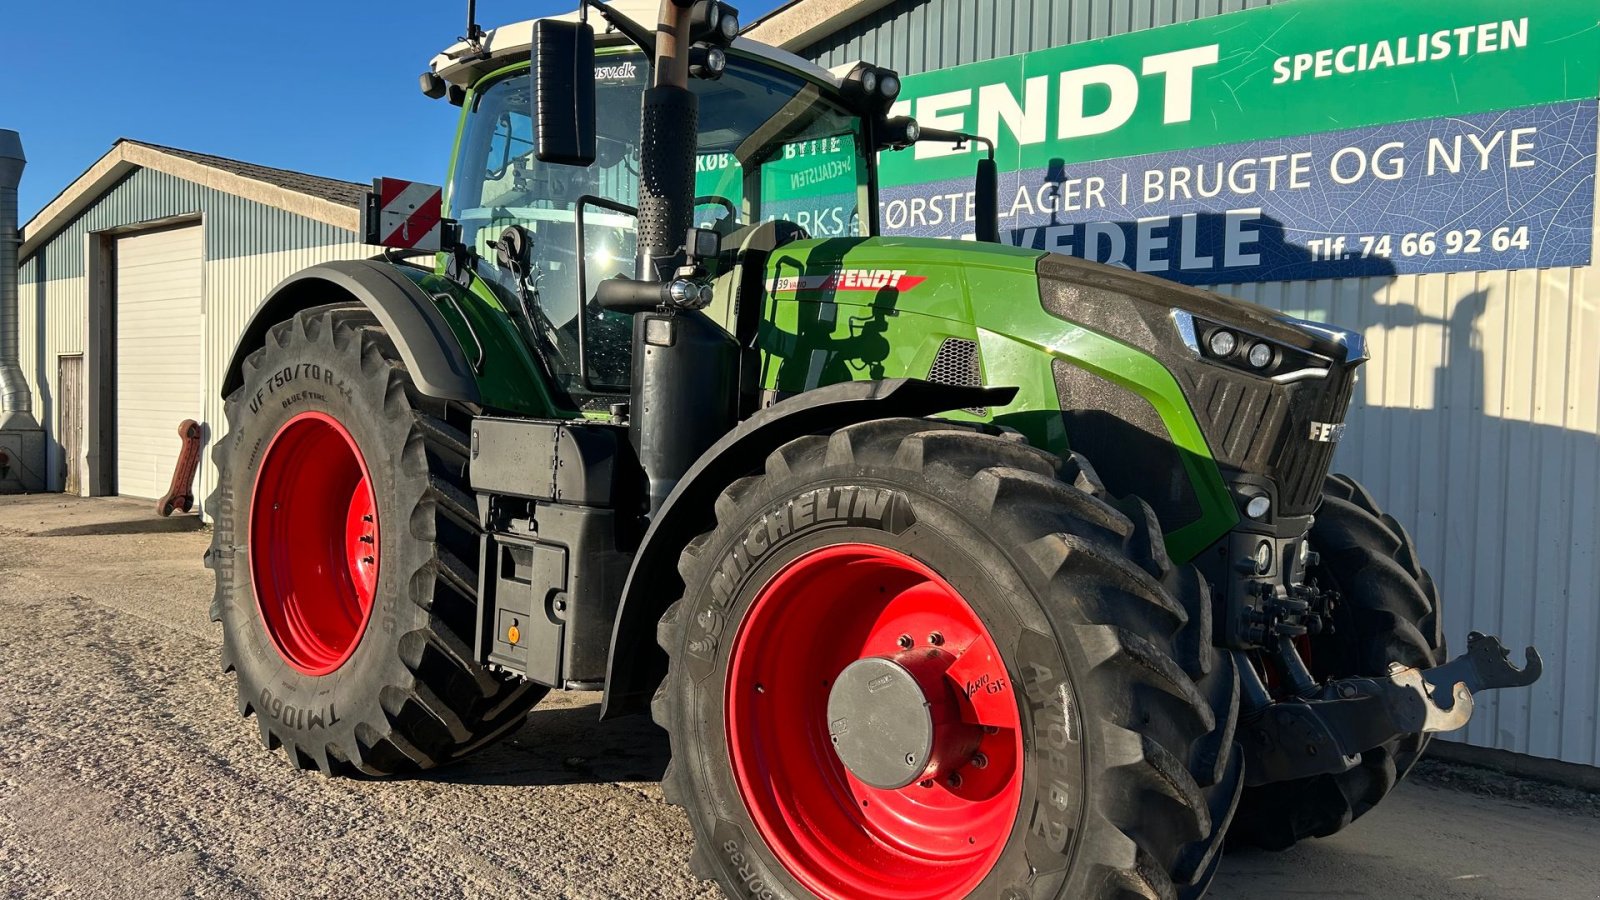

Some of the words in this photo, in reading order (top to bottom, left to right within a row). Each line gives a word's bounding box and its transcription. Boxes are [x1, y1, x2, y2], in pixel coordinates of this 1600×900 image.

[1272, 17, 1529, 85] SPECIALISTEN
[997, 176, 1105, 218] AGER
[1120, 172, 1128, 196] I
[1143, 151, 1312, 203] BRUGTE
[1329, 141, 1405, 185] OG
[1426, 127, 1537, 176] NYE
[1308, 236, 1350, 262] Tlf.
[1359, 234, 1392, 259] 74
[1400, 231, 1436, 257] 66
[1445, 228, 1481, 254] 92
[1491, 226, 1530, 251] 64
[833, 269, 907, 288] FENDT
[249, 387, 264, 415] VF
[266, 363, 321, 395] 750/70
[324, 369, 333, 386] R
[710, 485, 895, 608] MICHELIN
[260, 687, 341, 731] TM1060
